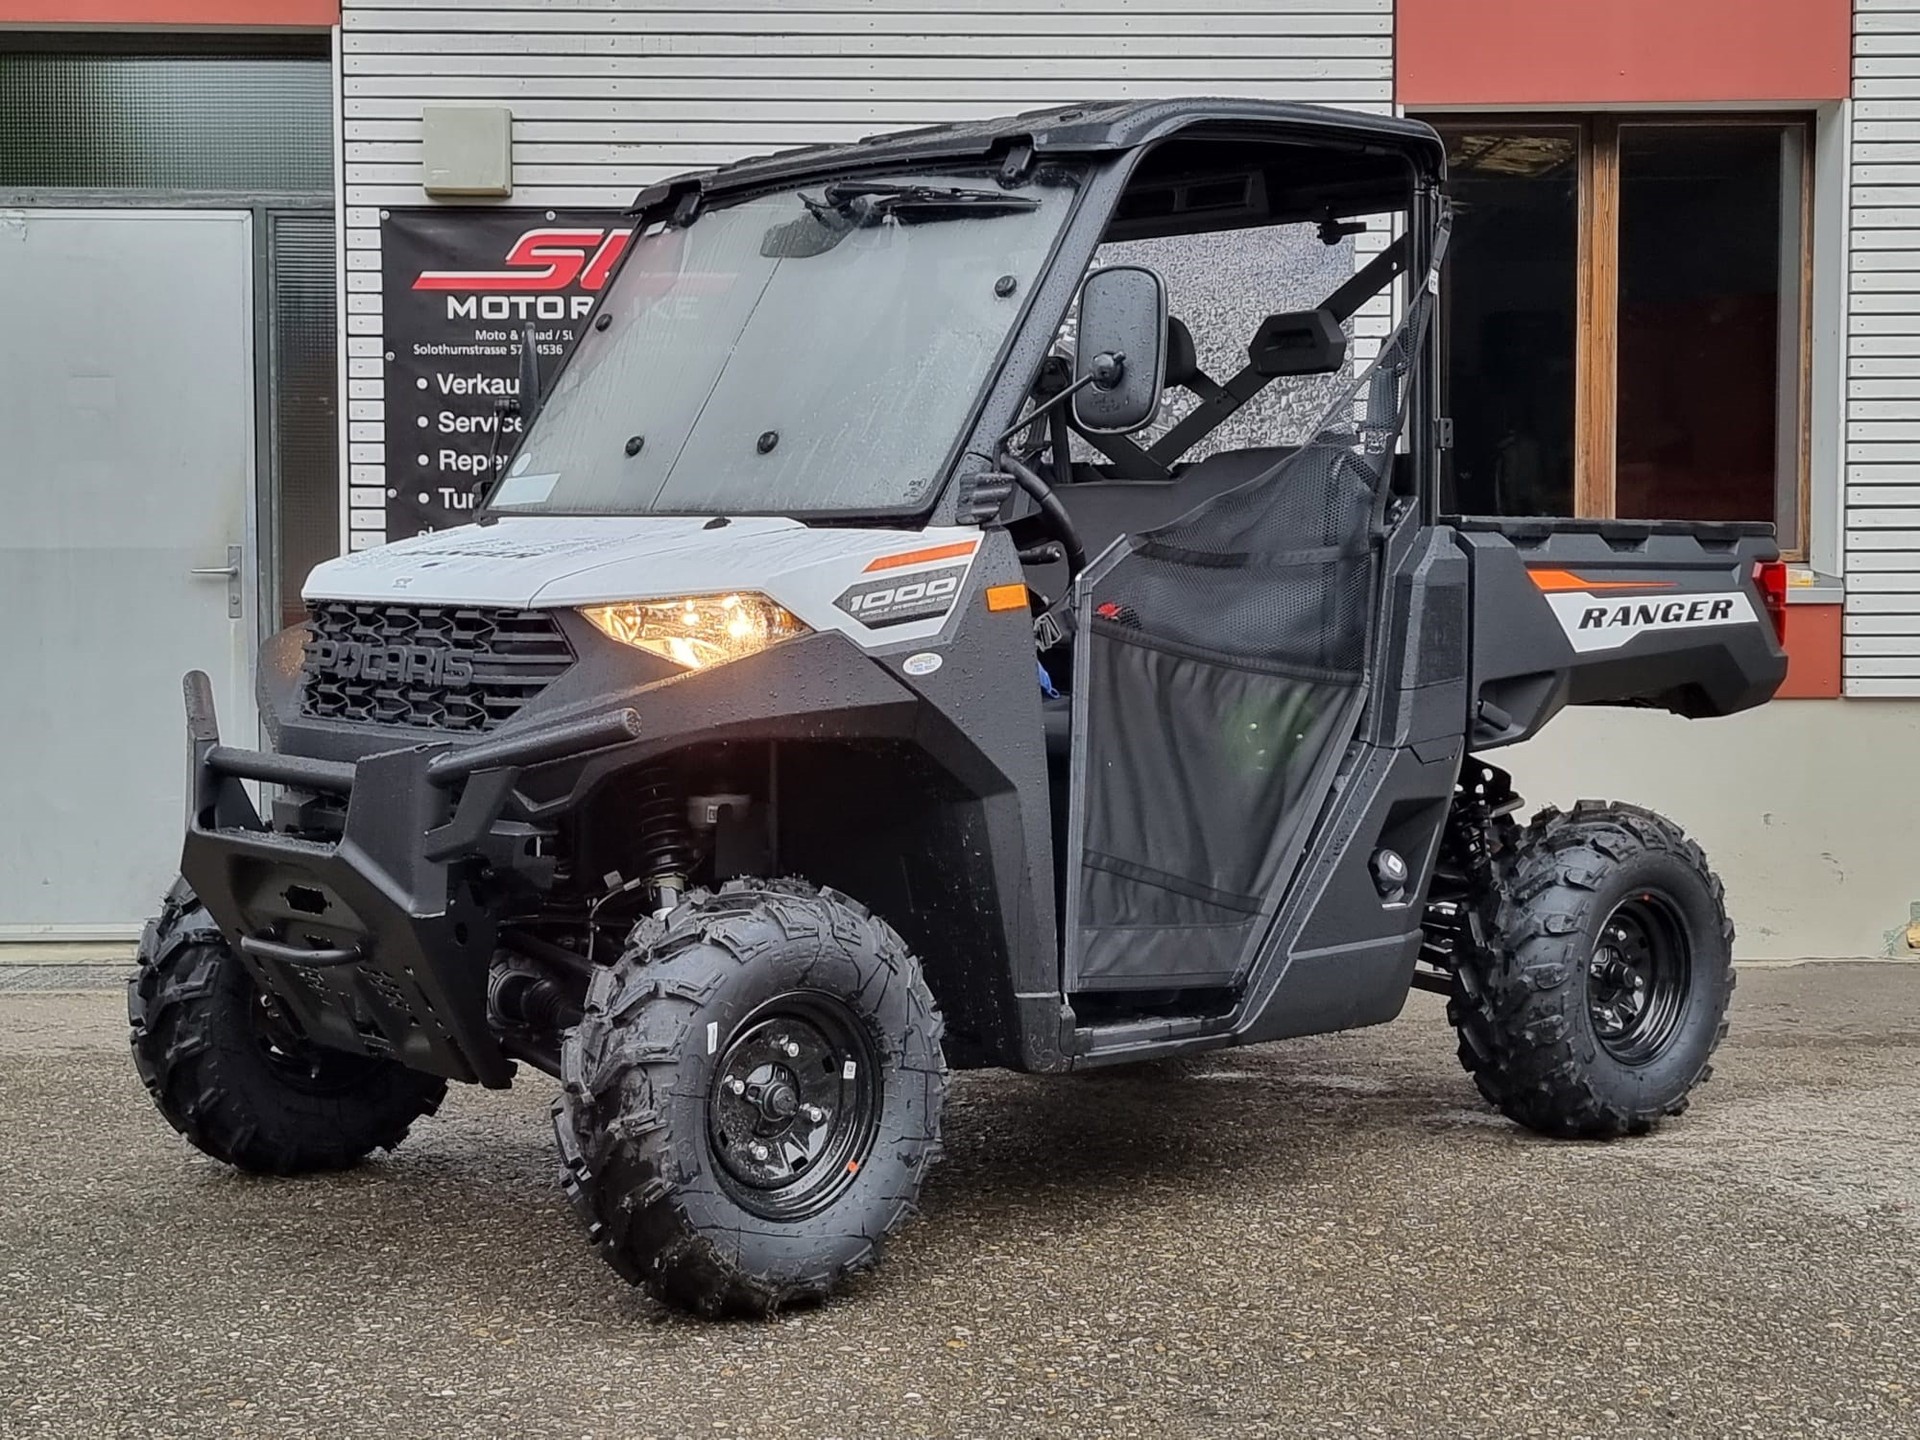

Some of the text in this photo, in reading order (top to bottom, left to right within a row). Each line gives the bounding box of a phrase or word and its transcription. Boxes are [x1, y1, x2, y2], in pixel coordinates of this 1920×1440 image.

[475, 330, 506, 341] Moto
[510, 330, 519, 341] &
[521, 329, 553, 341] ad
[413, 343, 507, 356] Solothurnstrasse
[536, 344, 564, 356] 4536
[437, 373, 520, 395] Verkau
[850, 577, 957, 612] 1000
[1578, 598, 1734, 630] RANGER
[308, 640, 474, 687] POLARIS
